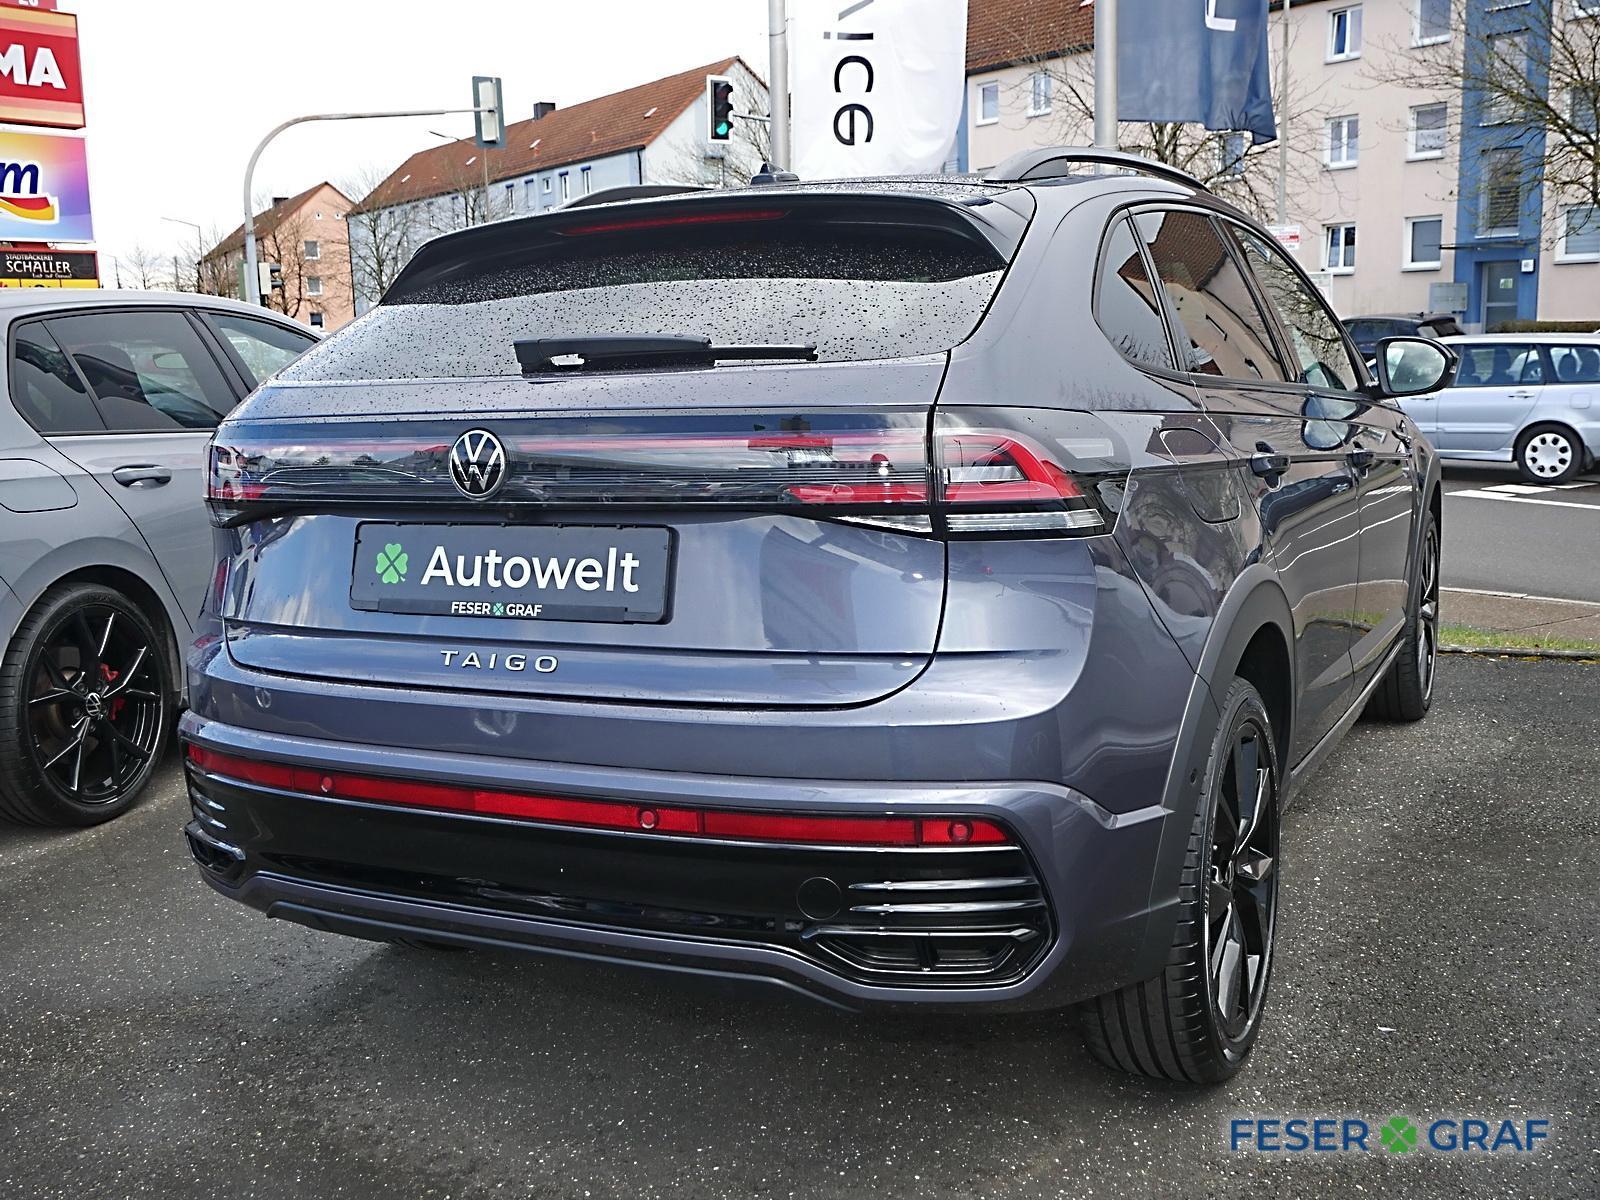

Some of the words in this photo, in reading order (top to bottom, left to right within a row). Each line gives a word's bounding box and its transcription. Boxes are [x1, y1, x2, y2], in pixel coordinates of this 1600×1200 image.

[0, 162, 39, 194] m
[420, 545, 640, 593] Autowelt
[451, 601, 491, 615] FESER
[506, 603, 543, 617] GRAF
[440, 650, 559, 673] TAIGO
